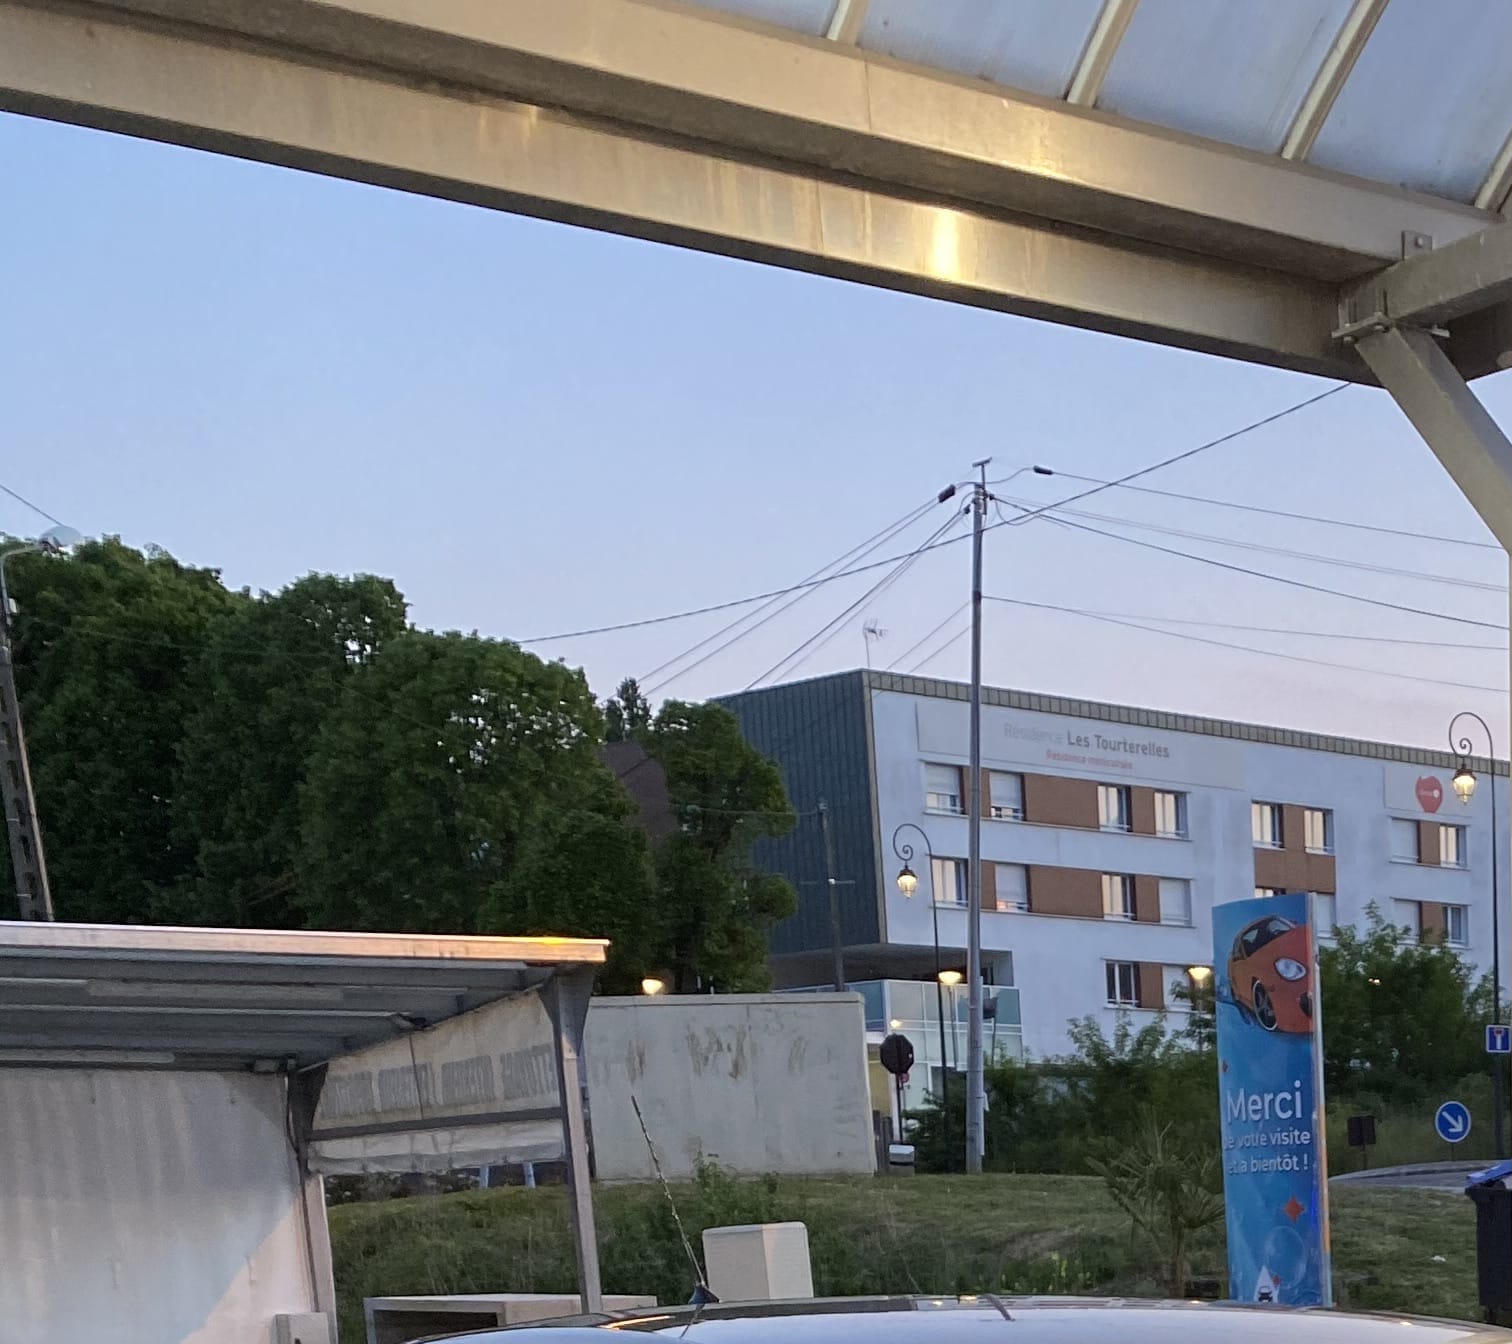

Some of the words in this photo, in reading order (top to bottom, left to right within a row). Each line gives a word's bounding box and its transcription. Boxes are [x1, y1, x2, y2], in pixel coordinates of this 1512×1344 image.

[1067, 730, 1090, 749] Les
[1095, 734, 1170, 758] Tourterelles
[1227, 1080, 1303, 1123] Merci
[1270, 1127, 1311, 1145] visite
[1250, 1153, 1300, 1173] bientôt
